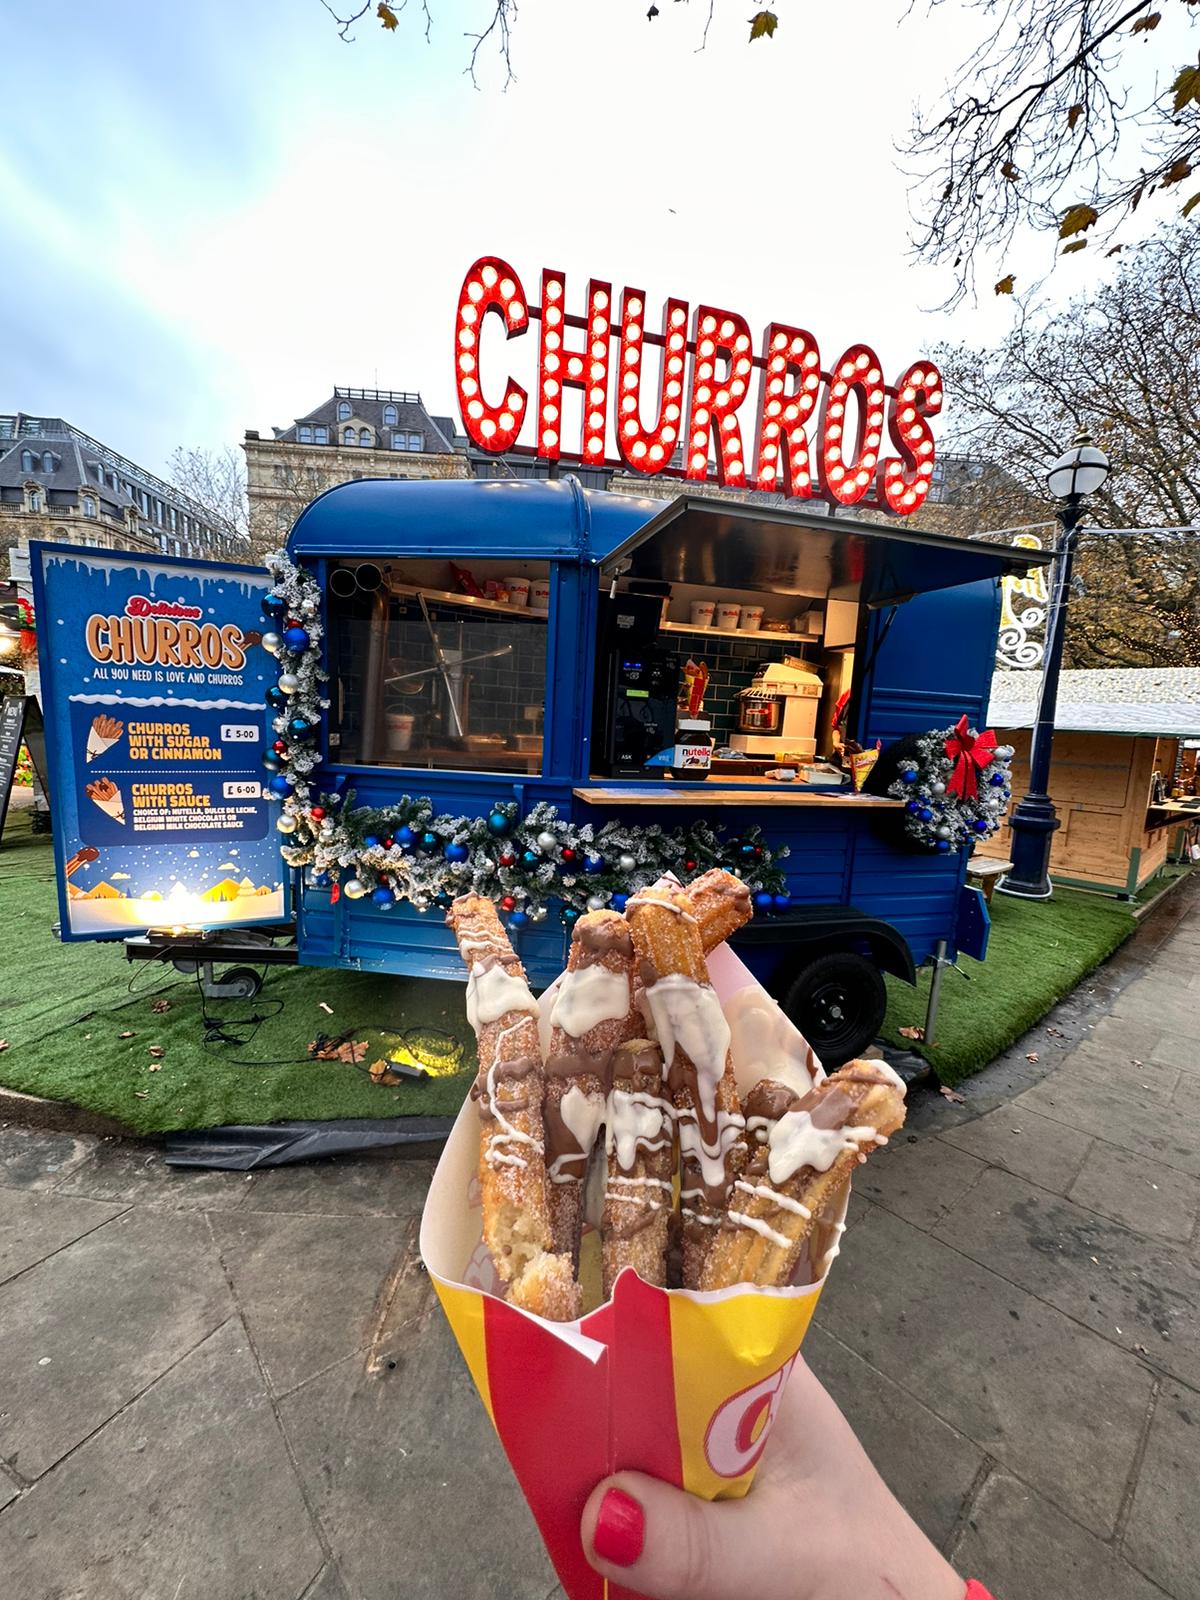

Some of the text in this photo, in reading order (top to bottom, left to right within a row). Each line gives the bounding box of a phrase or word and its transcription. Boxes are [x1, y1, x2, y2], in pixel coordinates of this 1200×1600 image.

[455, 256, 943, 515] CHURROS
[125, 596, 202, 619] Delicious
[87, 615, 246, 670] CHURROS
[93, 668, 244, 686] ALL YOU NEED IS LOVE AND CHURROS
[128, 722, 191, 735] CHURROS
[225, 729, 231, 738] £
[129, 735, 210, 748] WITH SUGAR
[129, 747, 222, 760] OR CINNAMON
[682, 747, 711, 757] nutella
[132, 783, 193, 796] CHURROS
[227, 785, 233, 795] £
[132, 795, 211, 808] WITH SAUCE
[133, 816, 165, 824] BELGIUM
[188, 814, 227, 822] CHOCOLATE
[134, 820, 244, 831] BELGIUM MILK CHOCOLATE SAUCE
